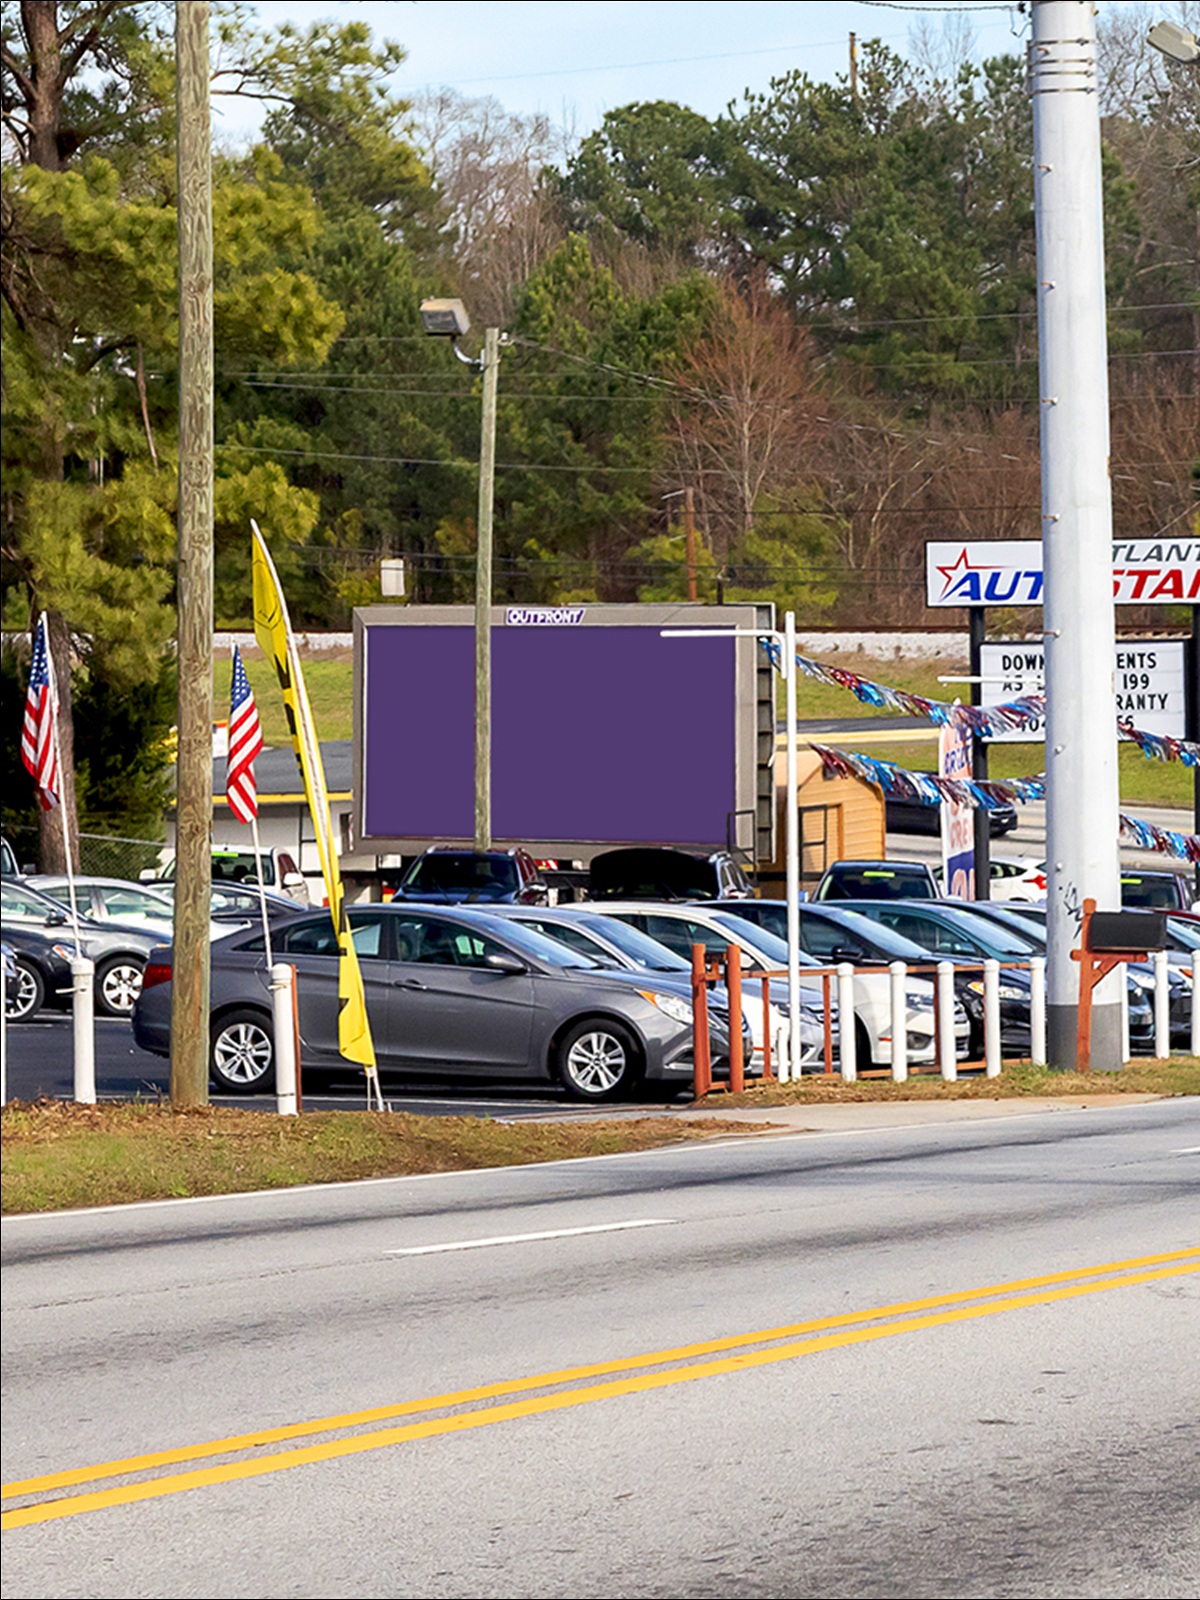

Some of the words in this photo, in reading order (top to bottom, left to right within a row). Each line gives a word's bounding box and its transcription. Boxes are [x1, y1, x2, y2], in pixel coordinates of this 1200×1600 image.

[943, 571, 1043, 600] AUT
[508, 609, 580, 624] OUTFRONT
[1123, 673, 1150, 690] 199
